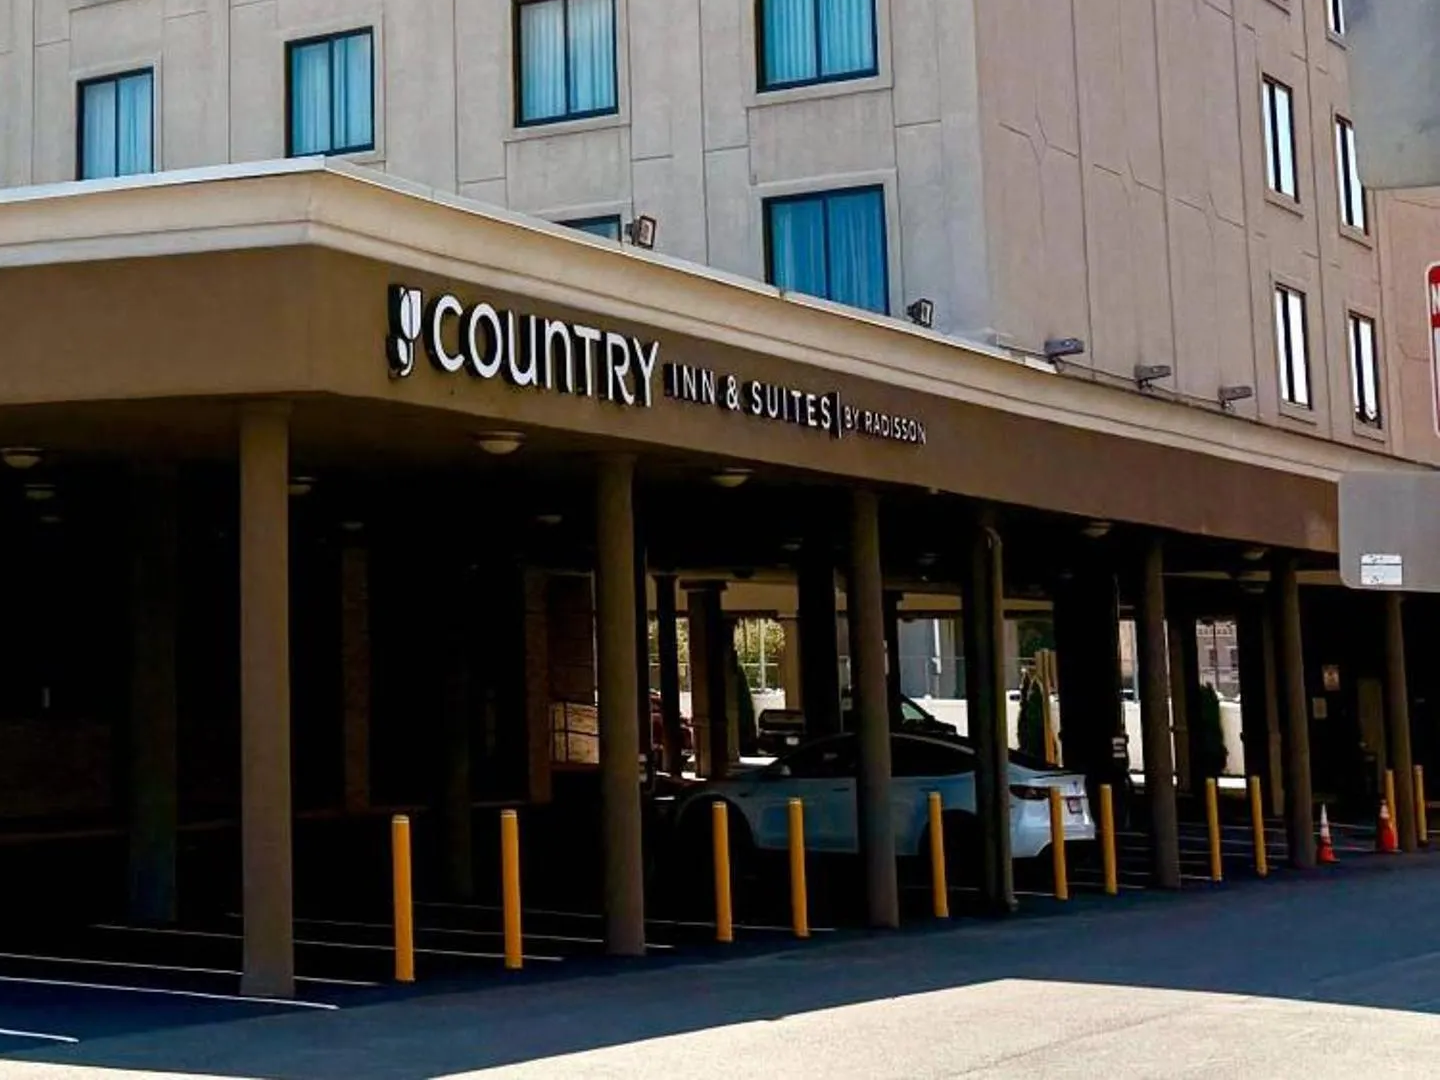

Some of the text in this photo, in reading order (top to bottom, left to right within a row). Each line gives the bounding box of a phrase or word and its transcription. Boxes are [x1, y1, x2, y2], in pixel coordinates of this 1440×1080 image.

[432, 294, 927, 445] COUNTRY INN & SUITES BY RADISSON
